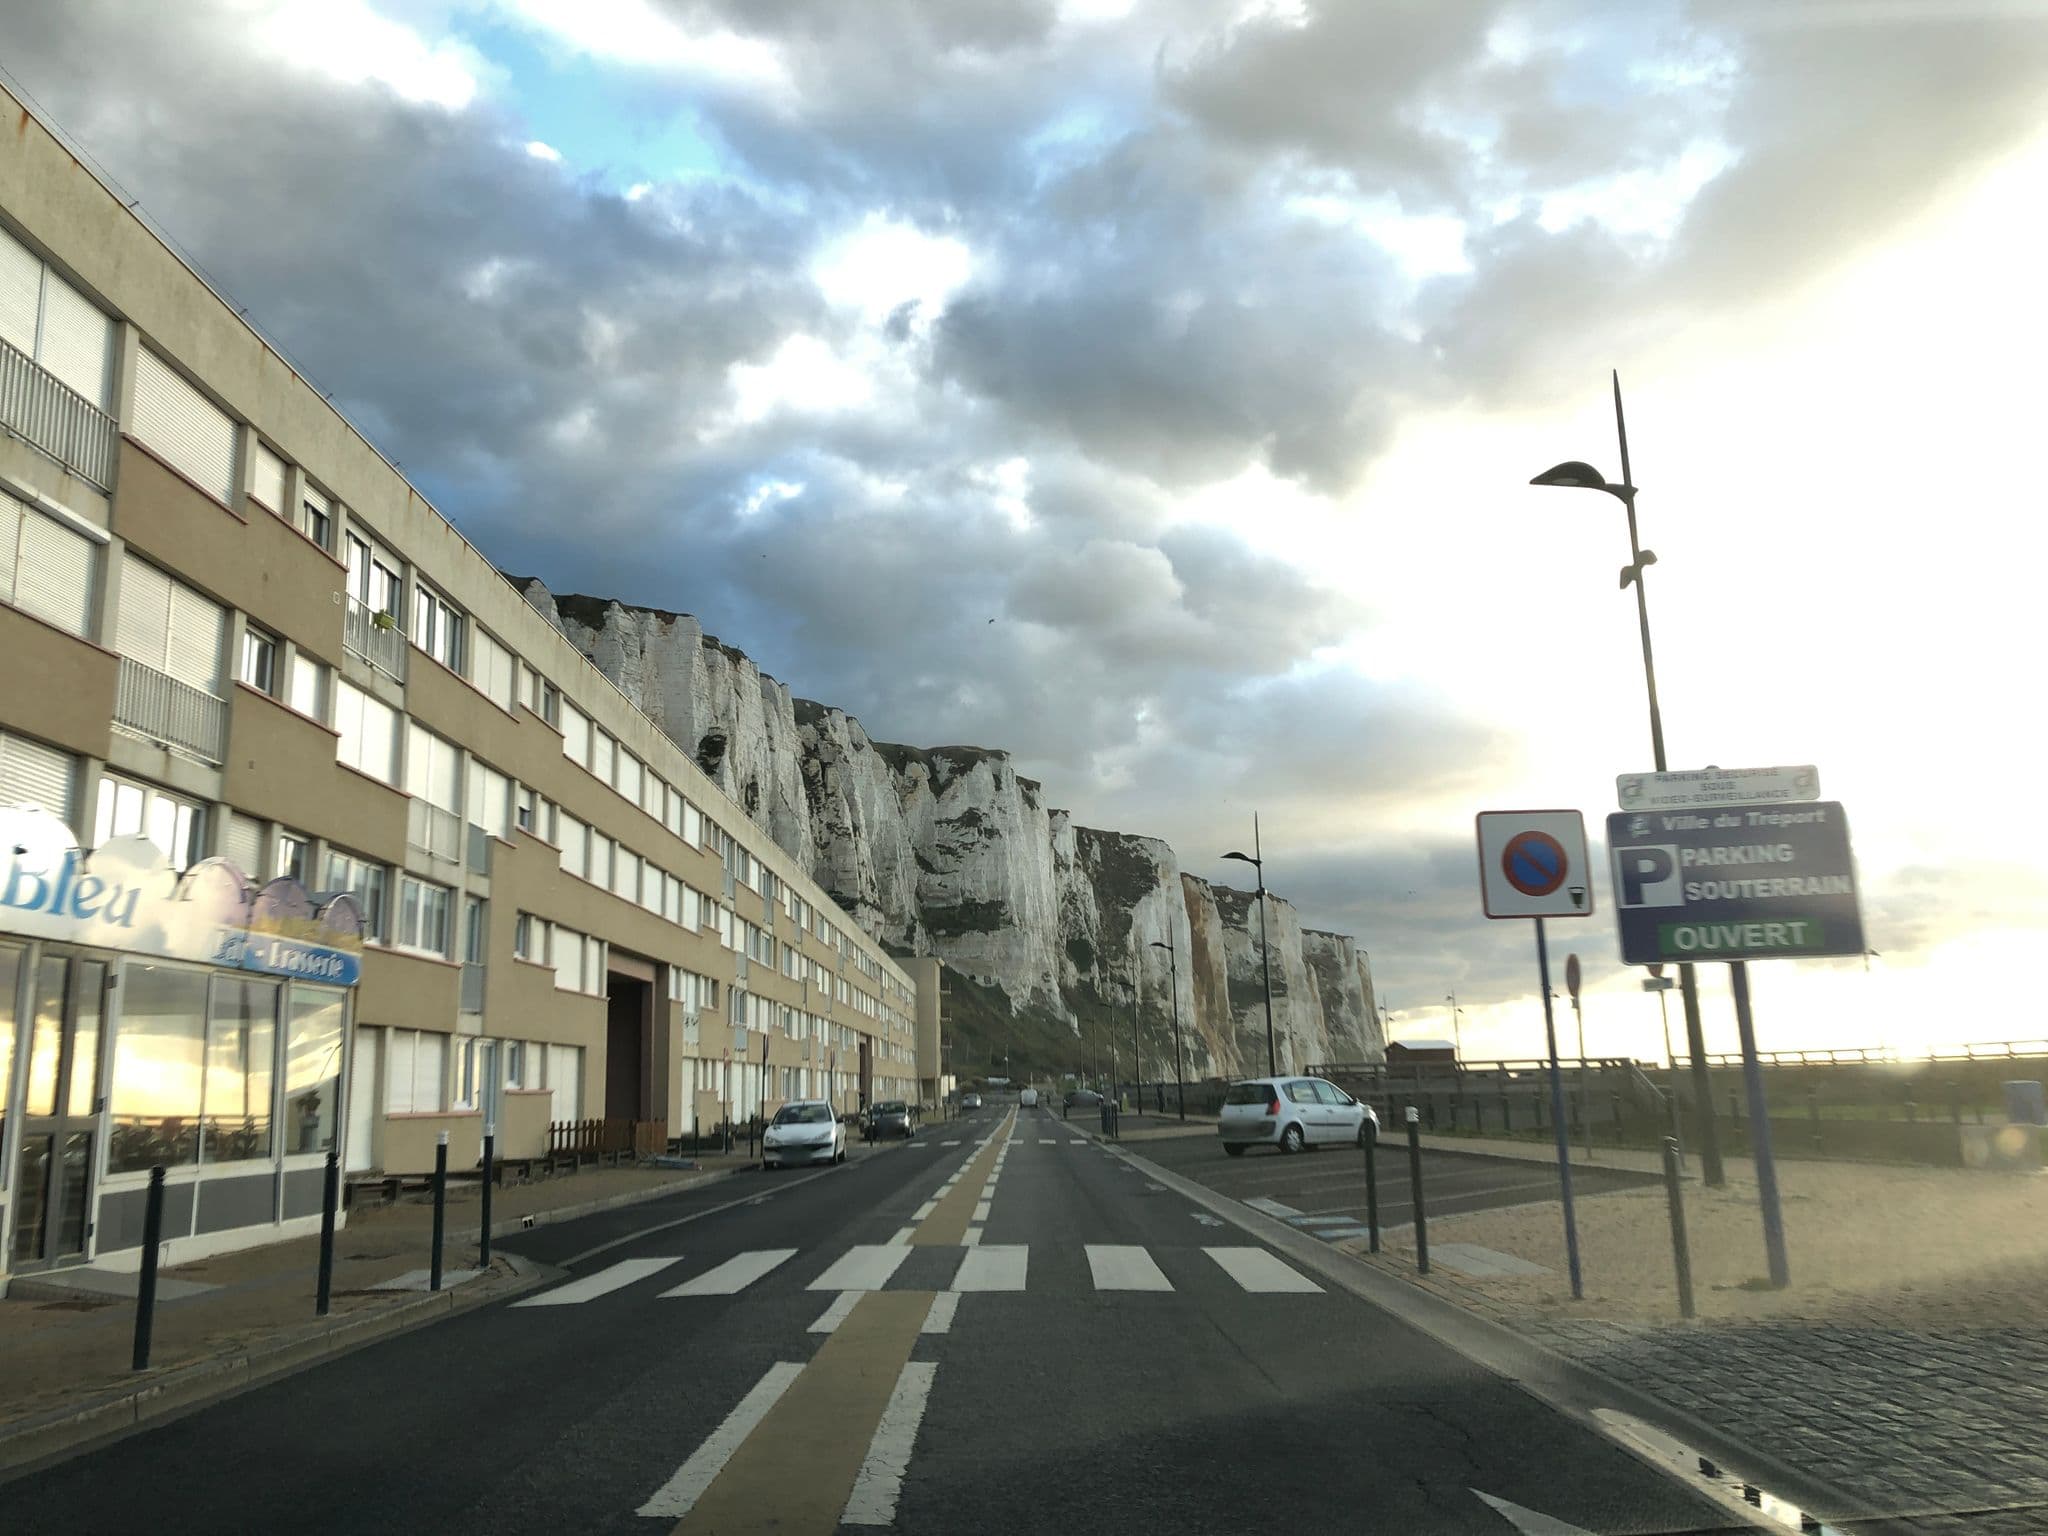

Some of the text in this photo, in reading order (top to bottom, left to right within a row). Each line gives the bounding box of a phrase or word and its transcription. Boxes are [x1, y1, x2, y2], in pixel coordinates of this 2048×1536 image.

[1661, 815, 1711, 832] Ville
[1713, 813, 1742, 828] du
[1681, 844, 1794, 866] PARKING
[1685, 875, 1853, 901] SOUTERRAIN
[1674, 922, 1808, 950] OUVERT
